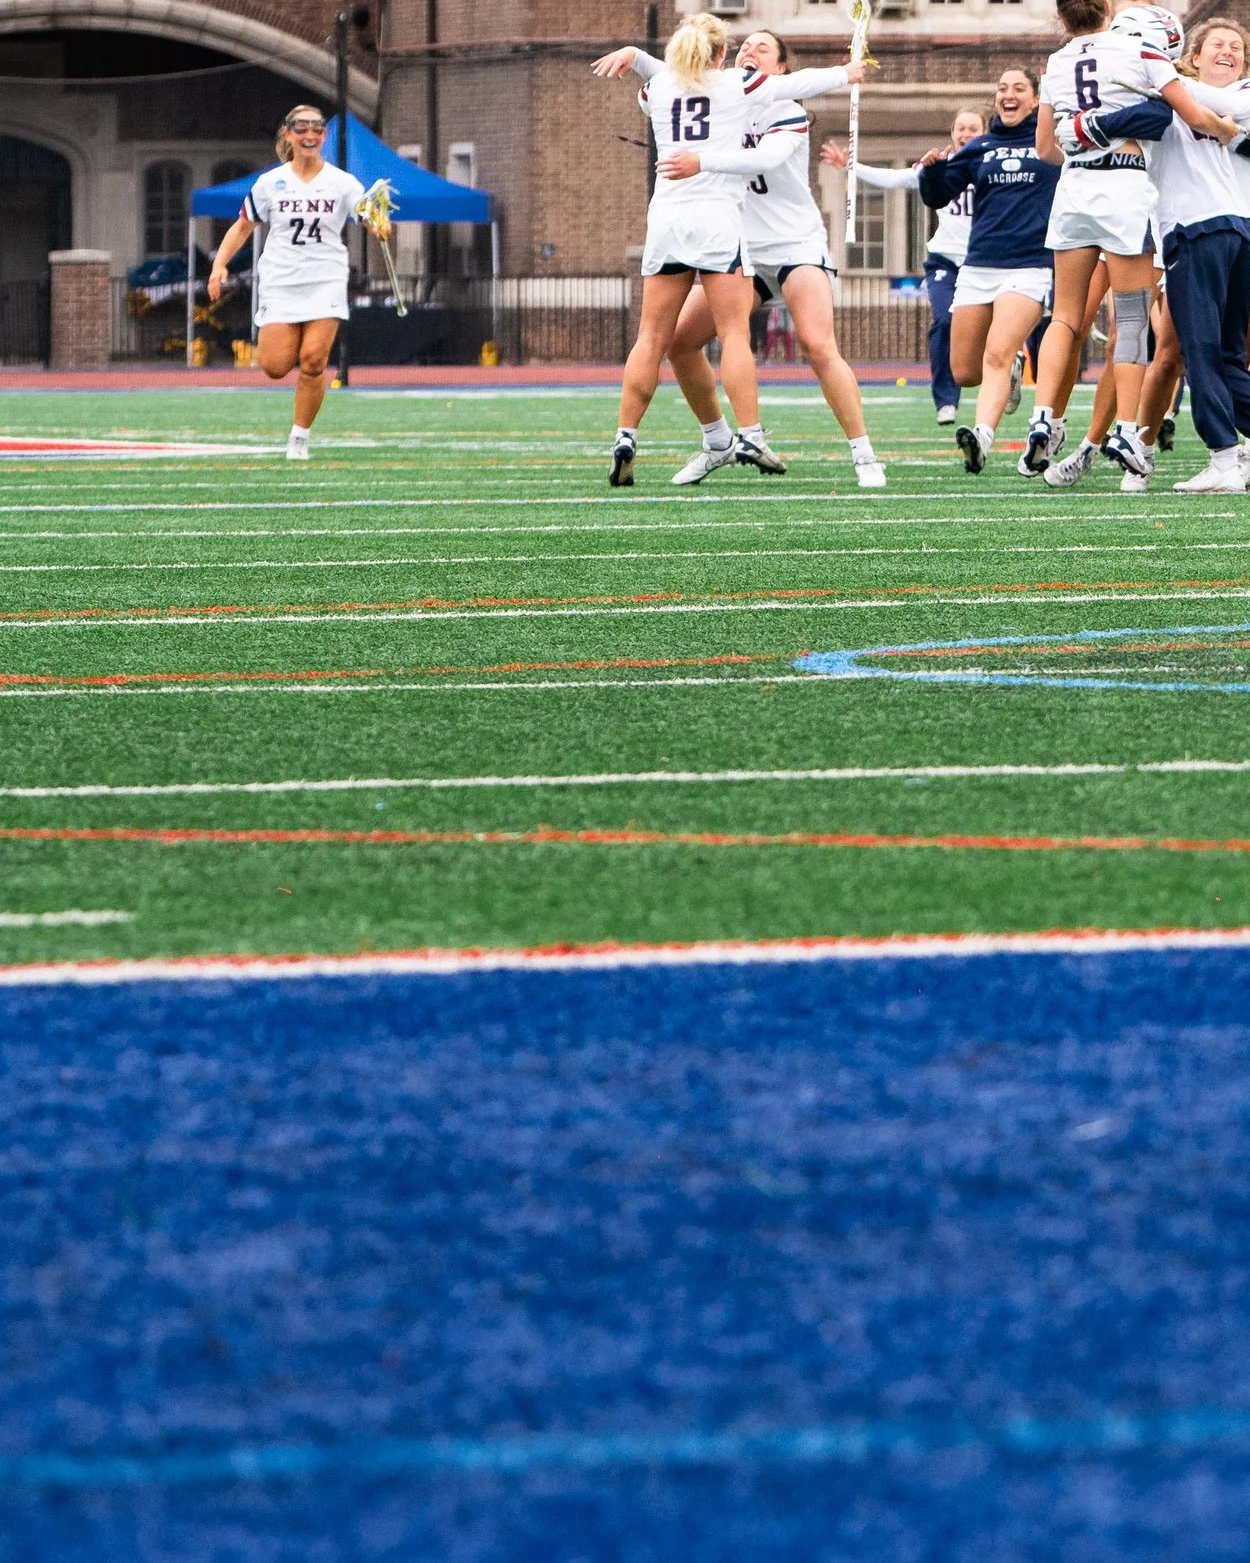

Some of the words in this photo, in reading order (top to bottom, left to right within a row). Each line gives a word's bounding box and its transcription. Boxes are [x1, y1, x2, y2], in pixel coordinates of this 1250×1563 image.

[1075, 58, 1101, 110] 6
[671, 96, 710, 141] 13
[1110, 152, 1145, 167] NIKE
[987, 172, 1035, 184] LACROSSE
[278, 199, 335, 213] PENN
[289, 217, 321, 245] 24
